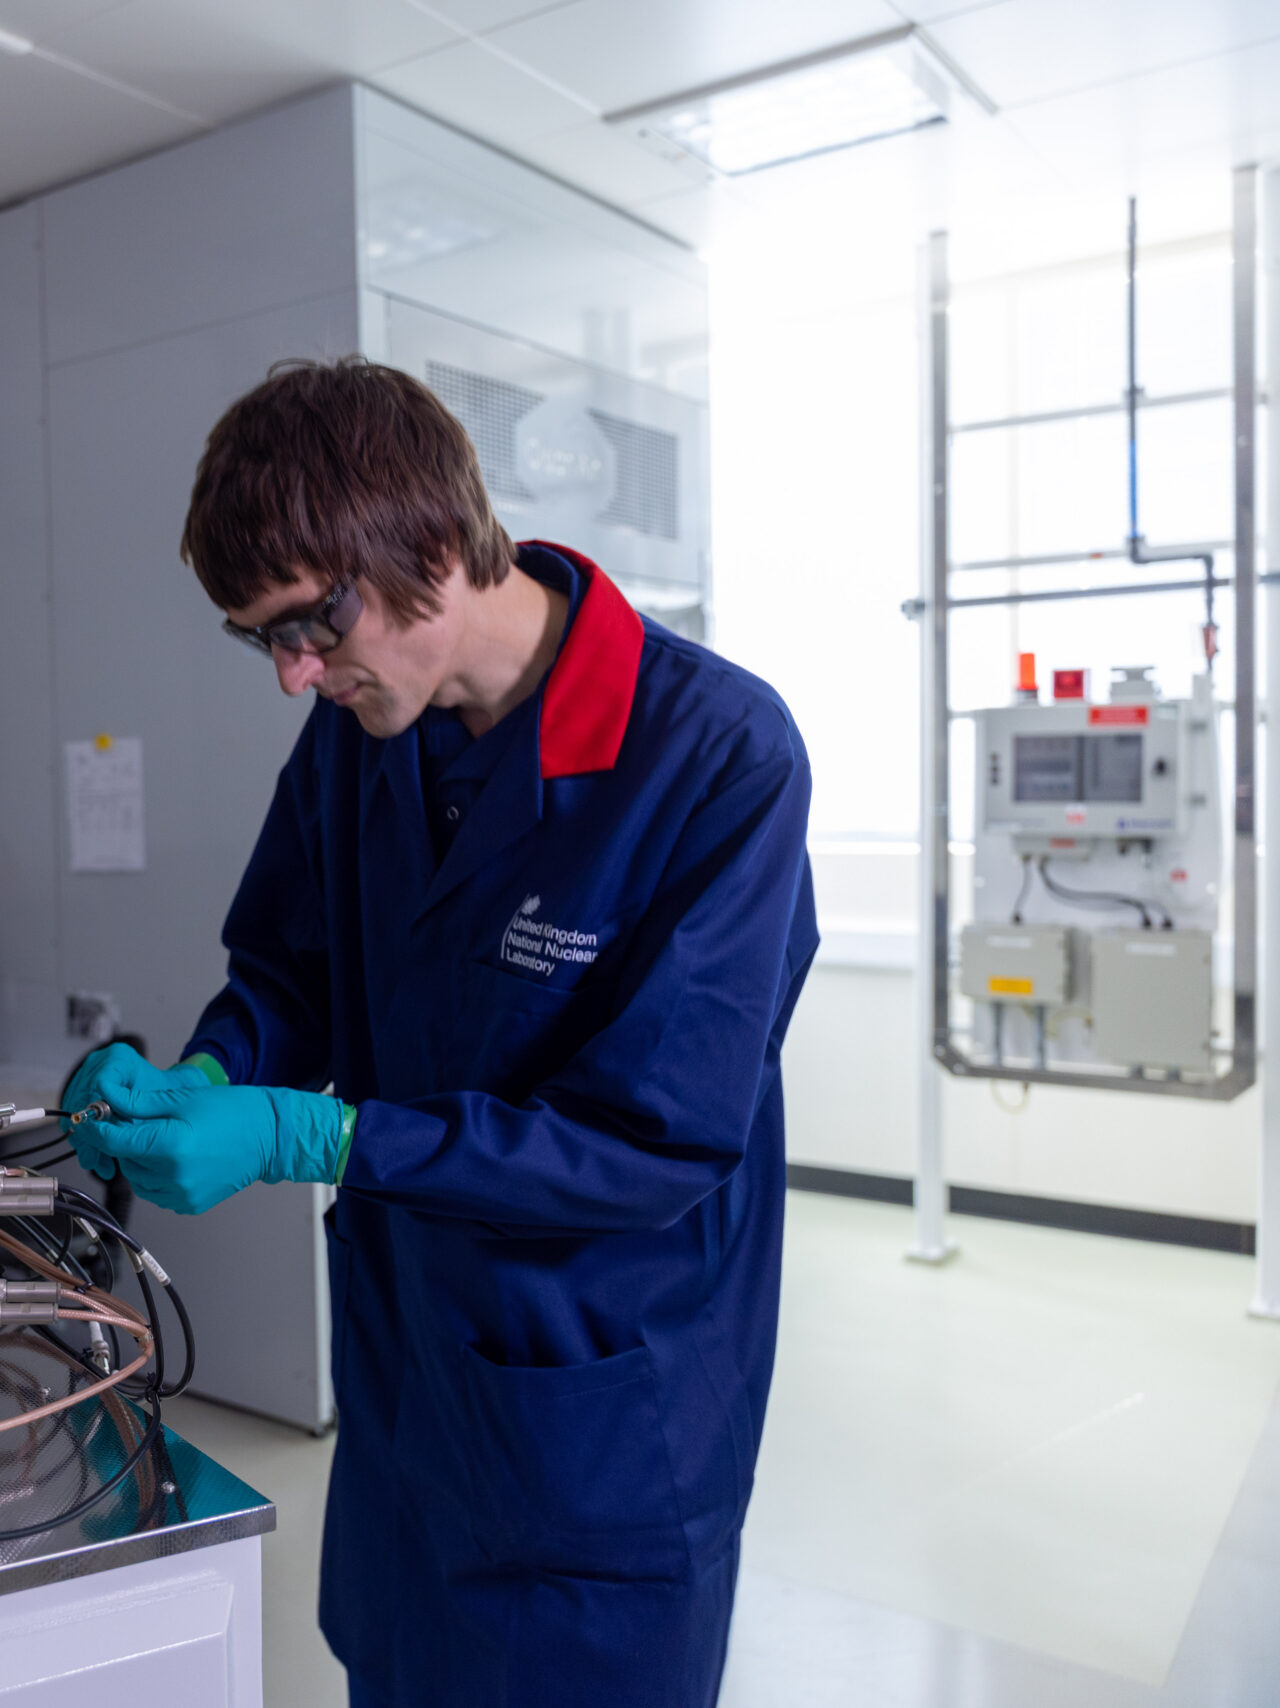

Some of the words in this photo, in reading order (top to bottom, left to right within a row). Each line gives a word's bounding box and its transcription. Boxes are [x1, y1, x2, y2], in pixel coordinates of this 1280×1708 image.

[513, 916, 543, 935] United
[543, 923, 596, 946] Kingdom
[507, 931, 543, 953] National
[545, 940, 598, 963] Nuclear
